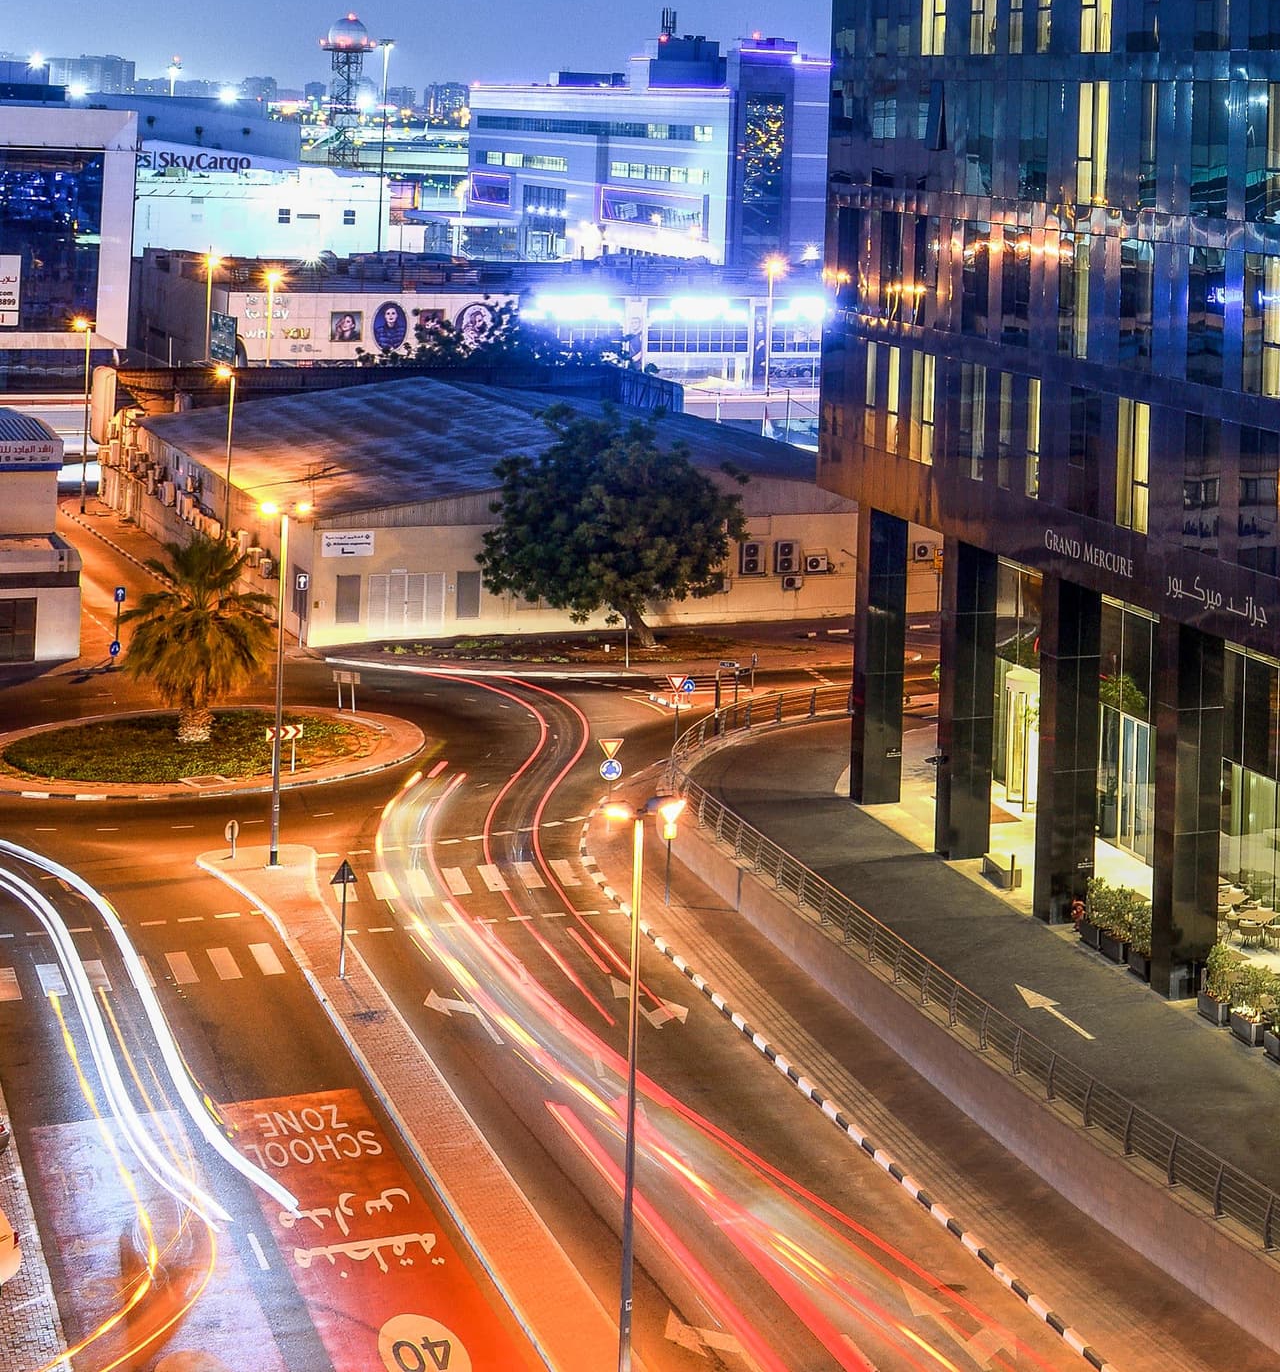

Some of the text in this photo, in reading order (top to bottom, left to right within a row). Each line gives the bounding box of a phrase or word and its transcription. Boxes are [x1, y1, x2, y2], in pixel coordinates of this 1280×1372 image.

[159, 151, 251, 174] SkyCargo
[1044, 529, 1134, 578] GRAND MERCURE
[1166, 576, 1267, 627] جراند ميركيور
[254, 1104, 349, 1138] ZONE
[243, 1130, 383, 1170] SCHOOL
[293, 1233, 446, 1279] منطقة
[392, 1336, 451, 1372] 40
